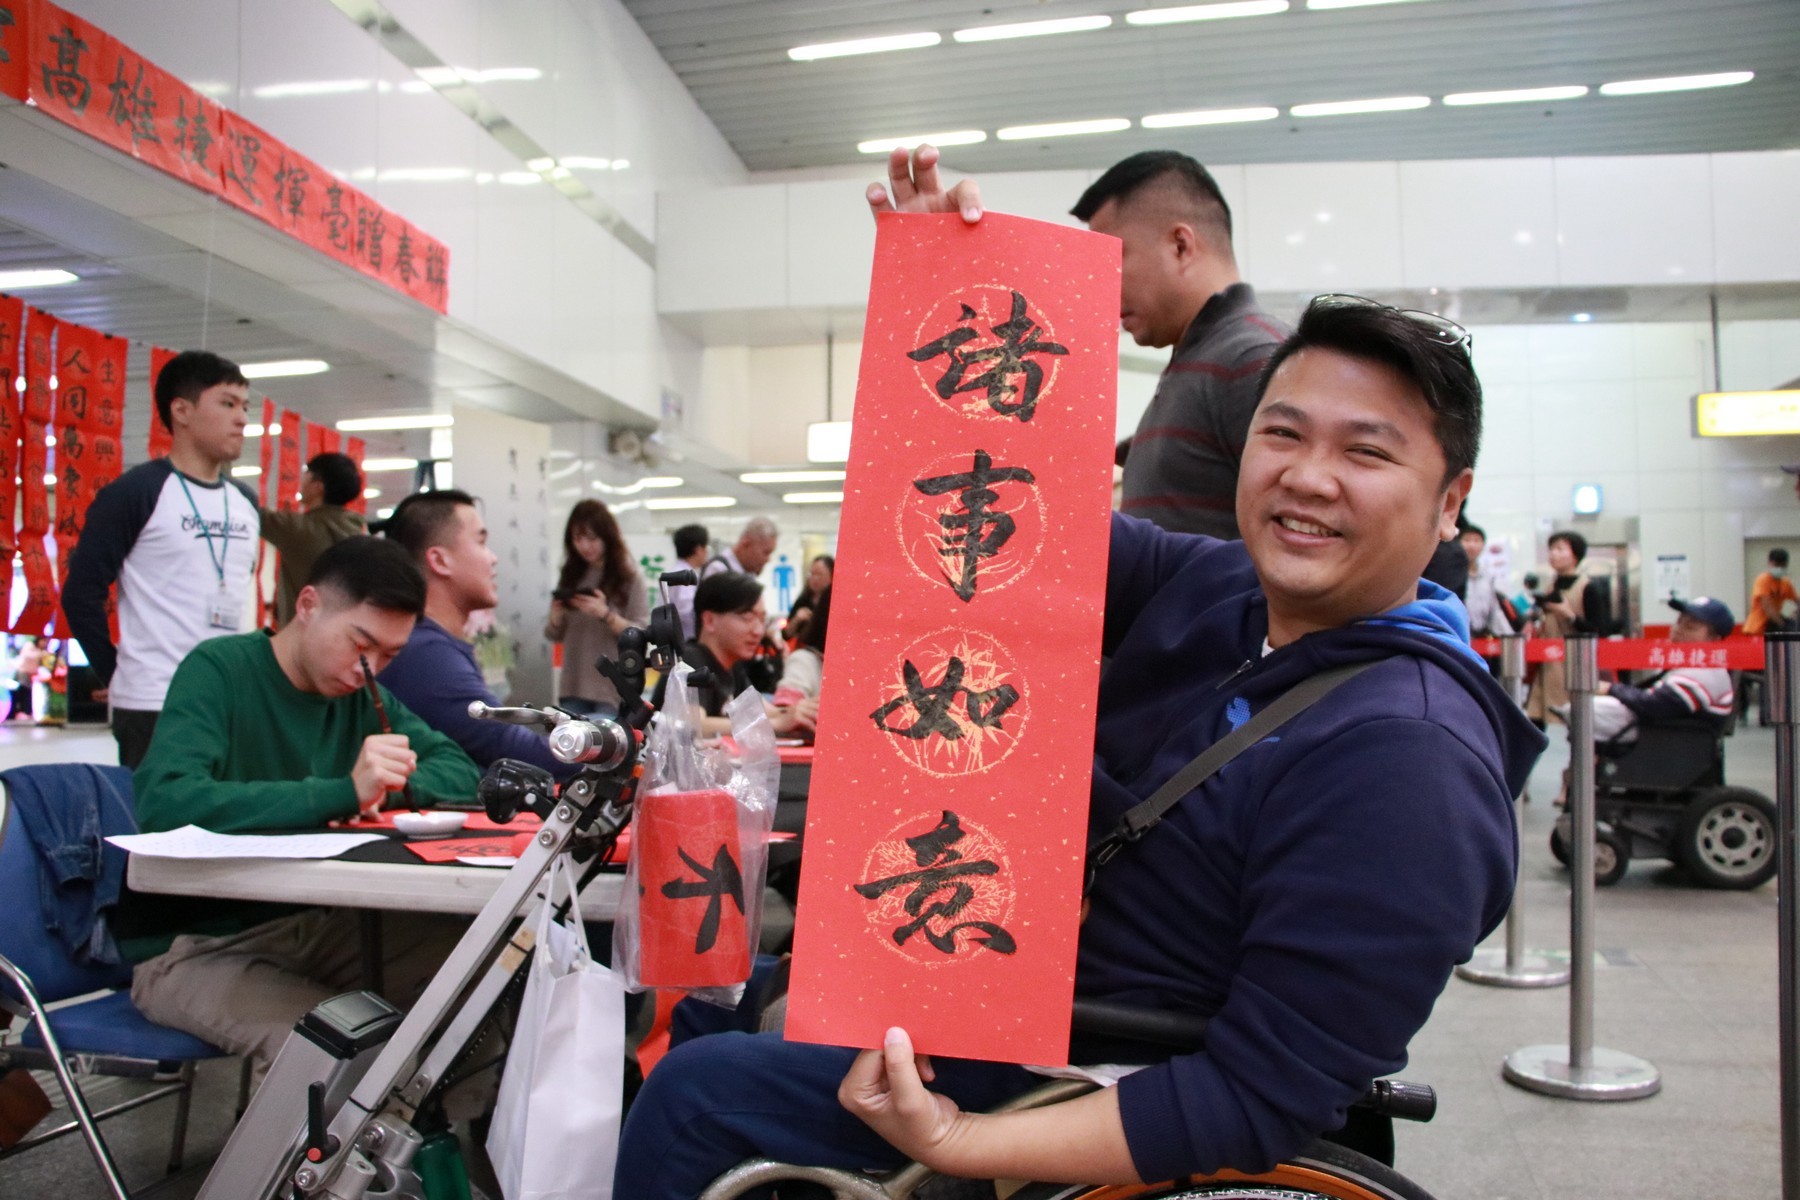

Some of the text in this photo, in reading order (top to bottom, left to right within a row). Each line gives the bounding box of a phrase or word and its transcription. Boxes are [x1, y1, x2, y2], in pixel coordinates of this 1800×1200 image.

[853, 290, 1070, 956] 諸事如意
[1648, 646, 1728, 668] 高雄捷運
